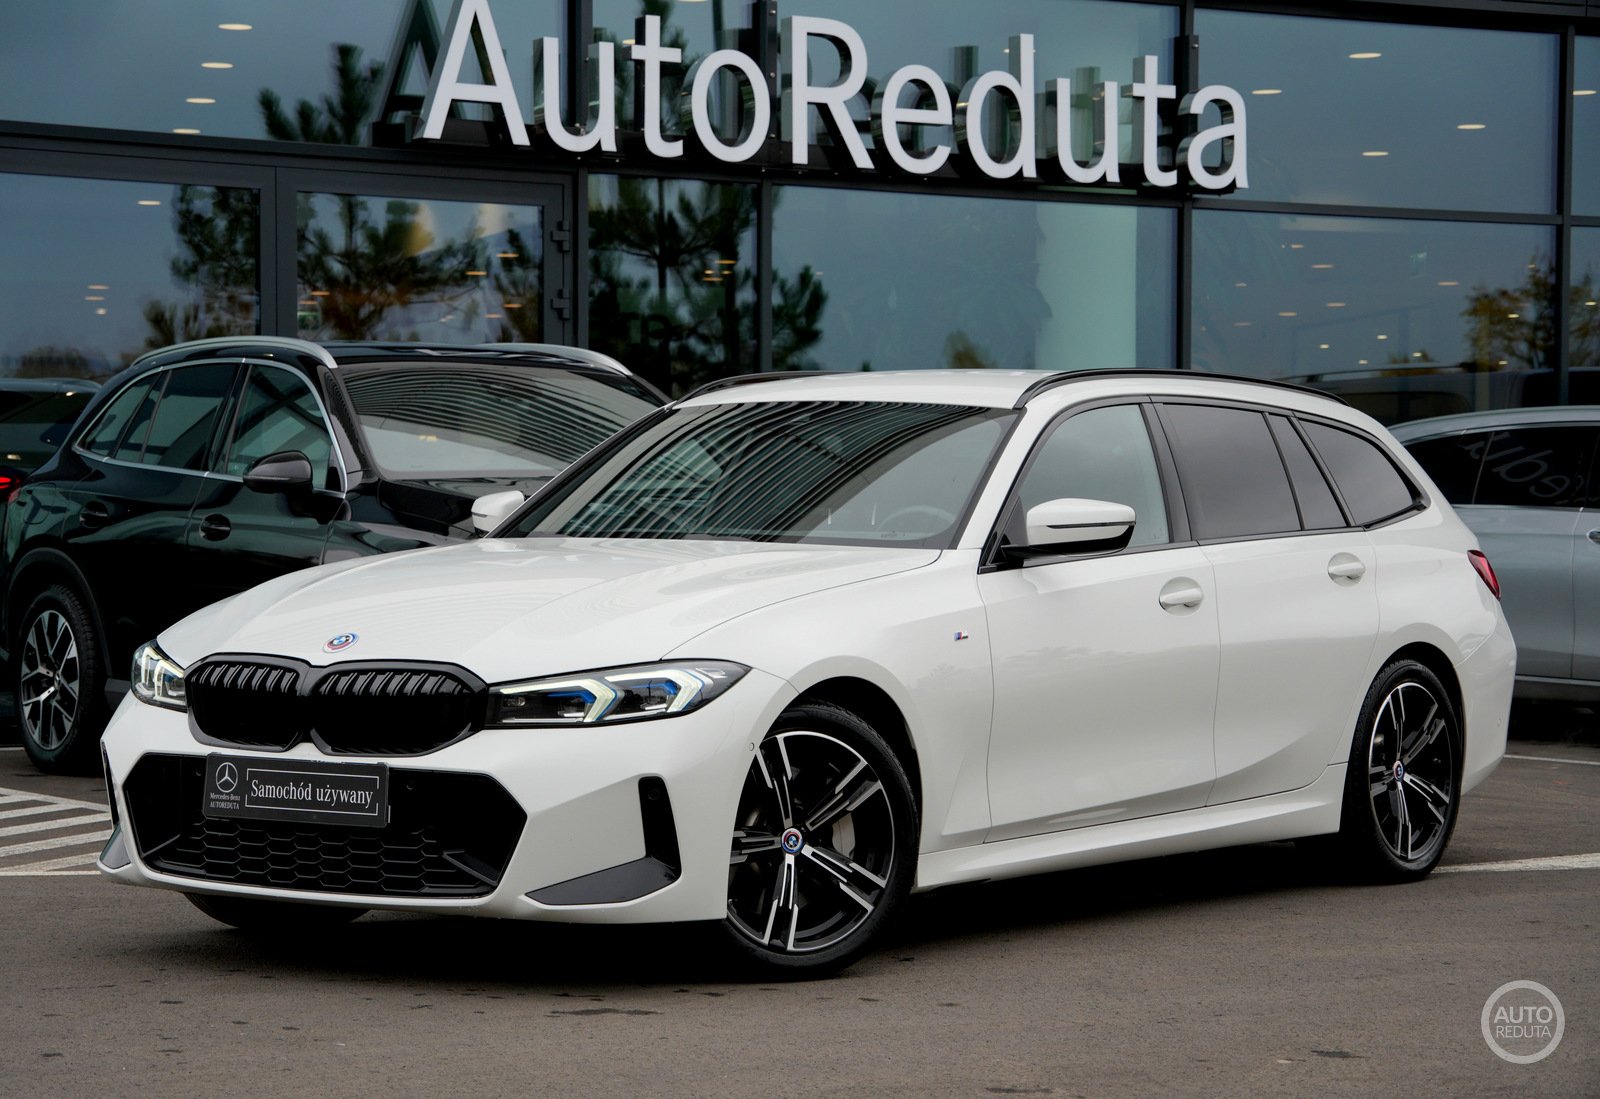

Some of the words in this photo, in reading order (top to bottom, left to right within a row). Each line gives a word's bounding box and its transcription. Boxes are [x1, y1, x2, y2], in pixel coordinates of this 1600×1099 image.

[420, 0, 1249, 191] AutoReduta
[210, 792, 241, 801] Mercedes-Benz
[251, 779, 312, 801] Samochód
[316, 784, 373, 808] używany
